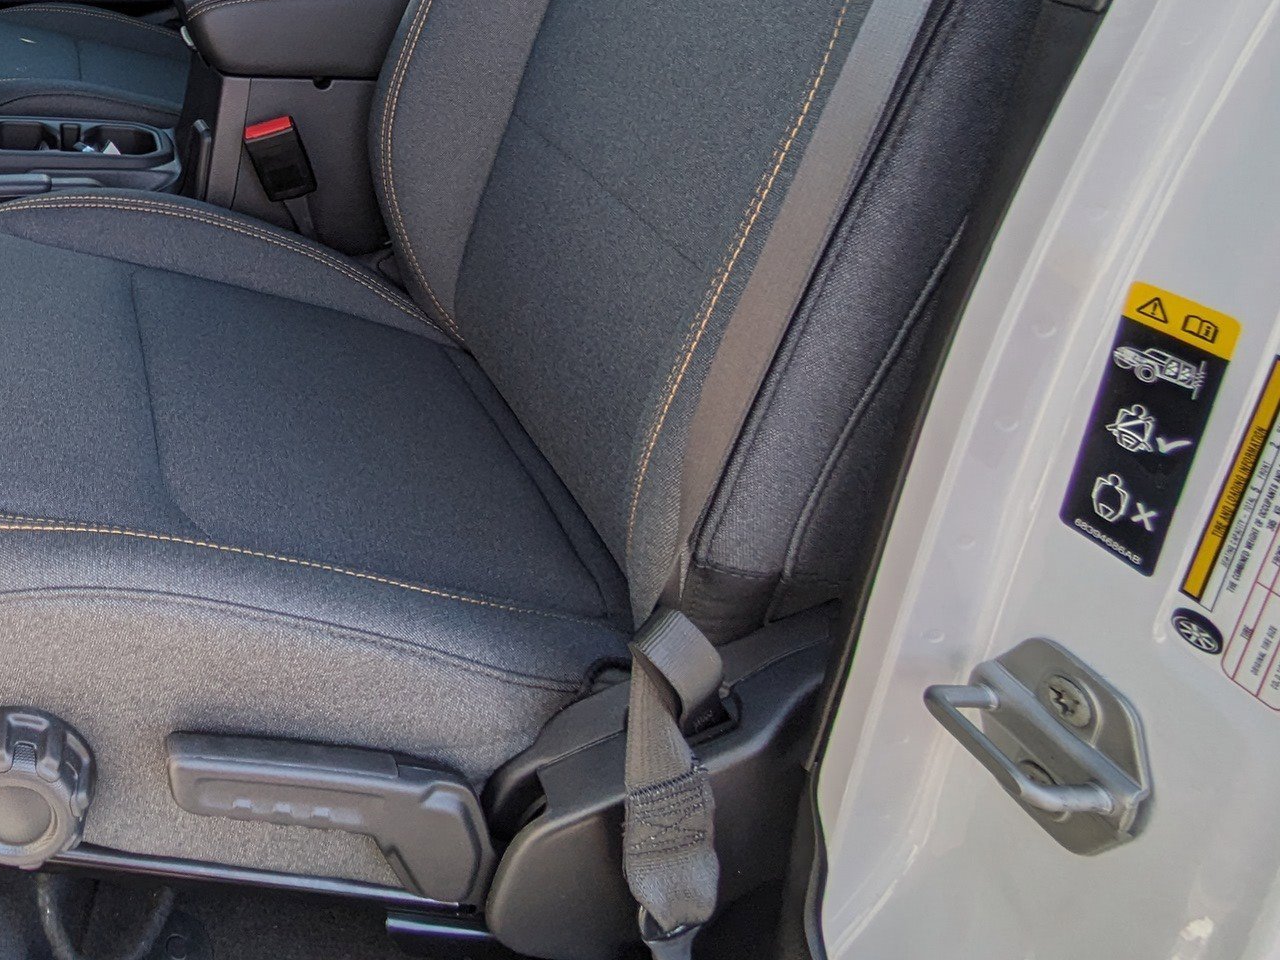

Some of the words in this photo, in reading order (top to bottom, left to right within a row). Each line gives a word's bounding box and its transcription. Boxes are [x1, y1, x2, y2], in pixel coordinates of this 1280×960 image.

[1211, 521, 1226, 538] TIRE
[1219, 506, 1233, 520] AND
[1226, 475, 1245, 506] LOADING
[1238, 425, 1267, 477] INFORMATION
[1244, 497, 1256, 512] TOTAL
[1257, 461, 1271, 480] FRONT
[1258, 483, 1279, 518] OCCUPANTS
[1254, 518, 1263, 527] OF
[1245, 527, 1260, 550] WEIGHT
[1232, 550, 1250, 580] COMBINED
[1226, 580, 1238, 593] THE
